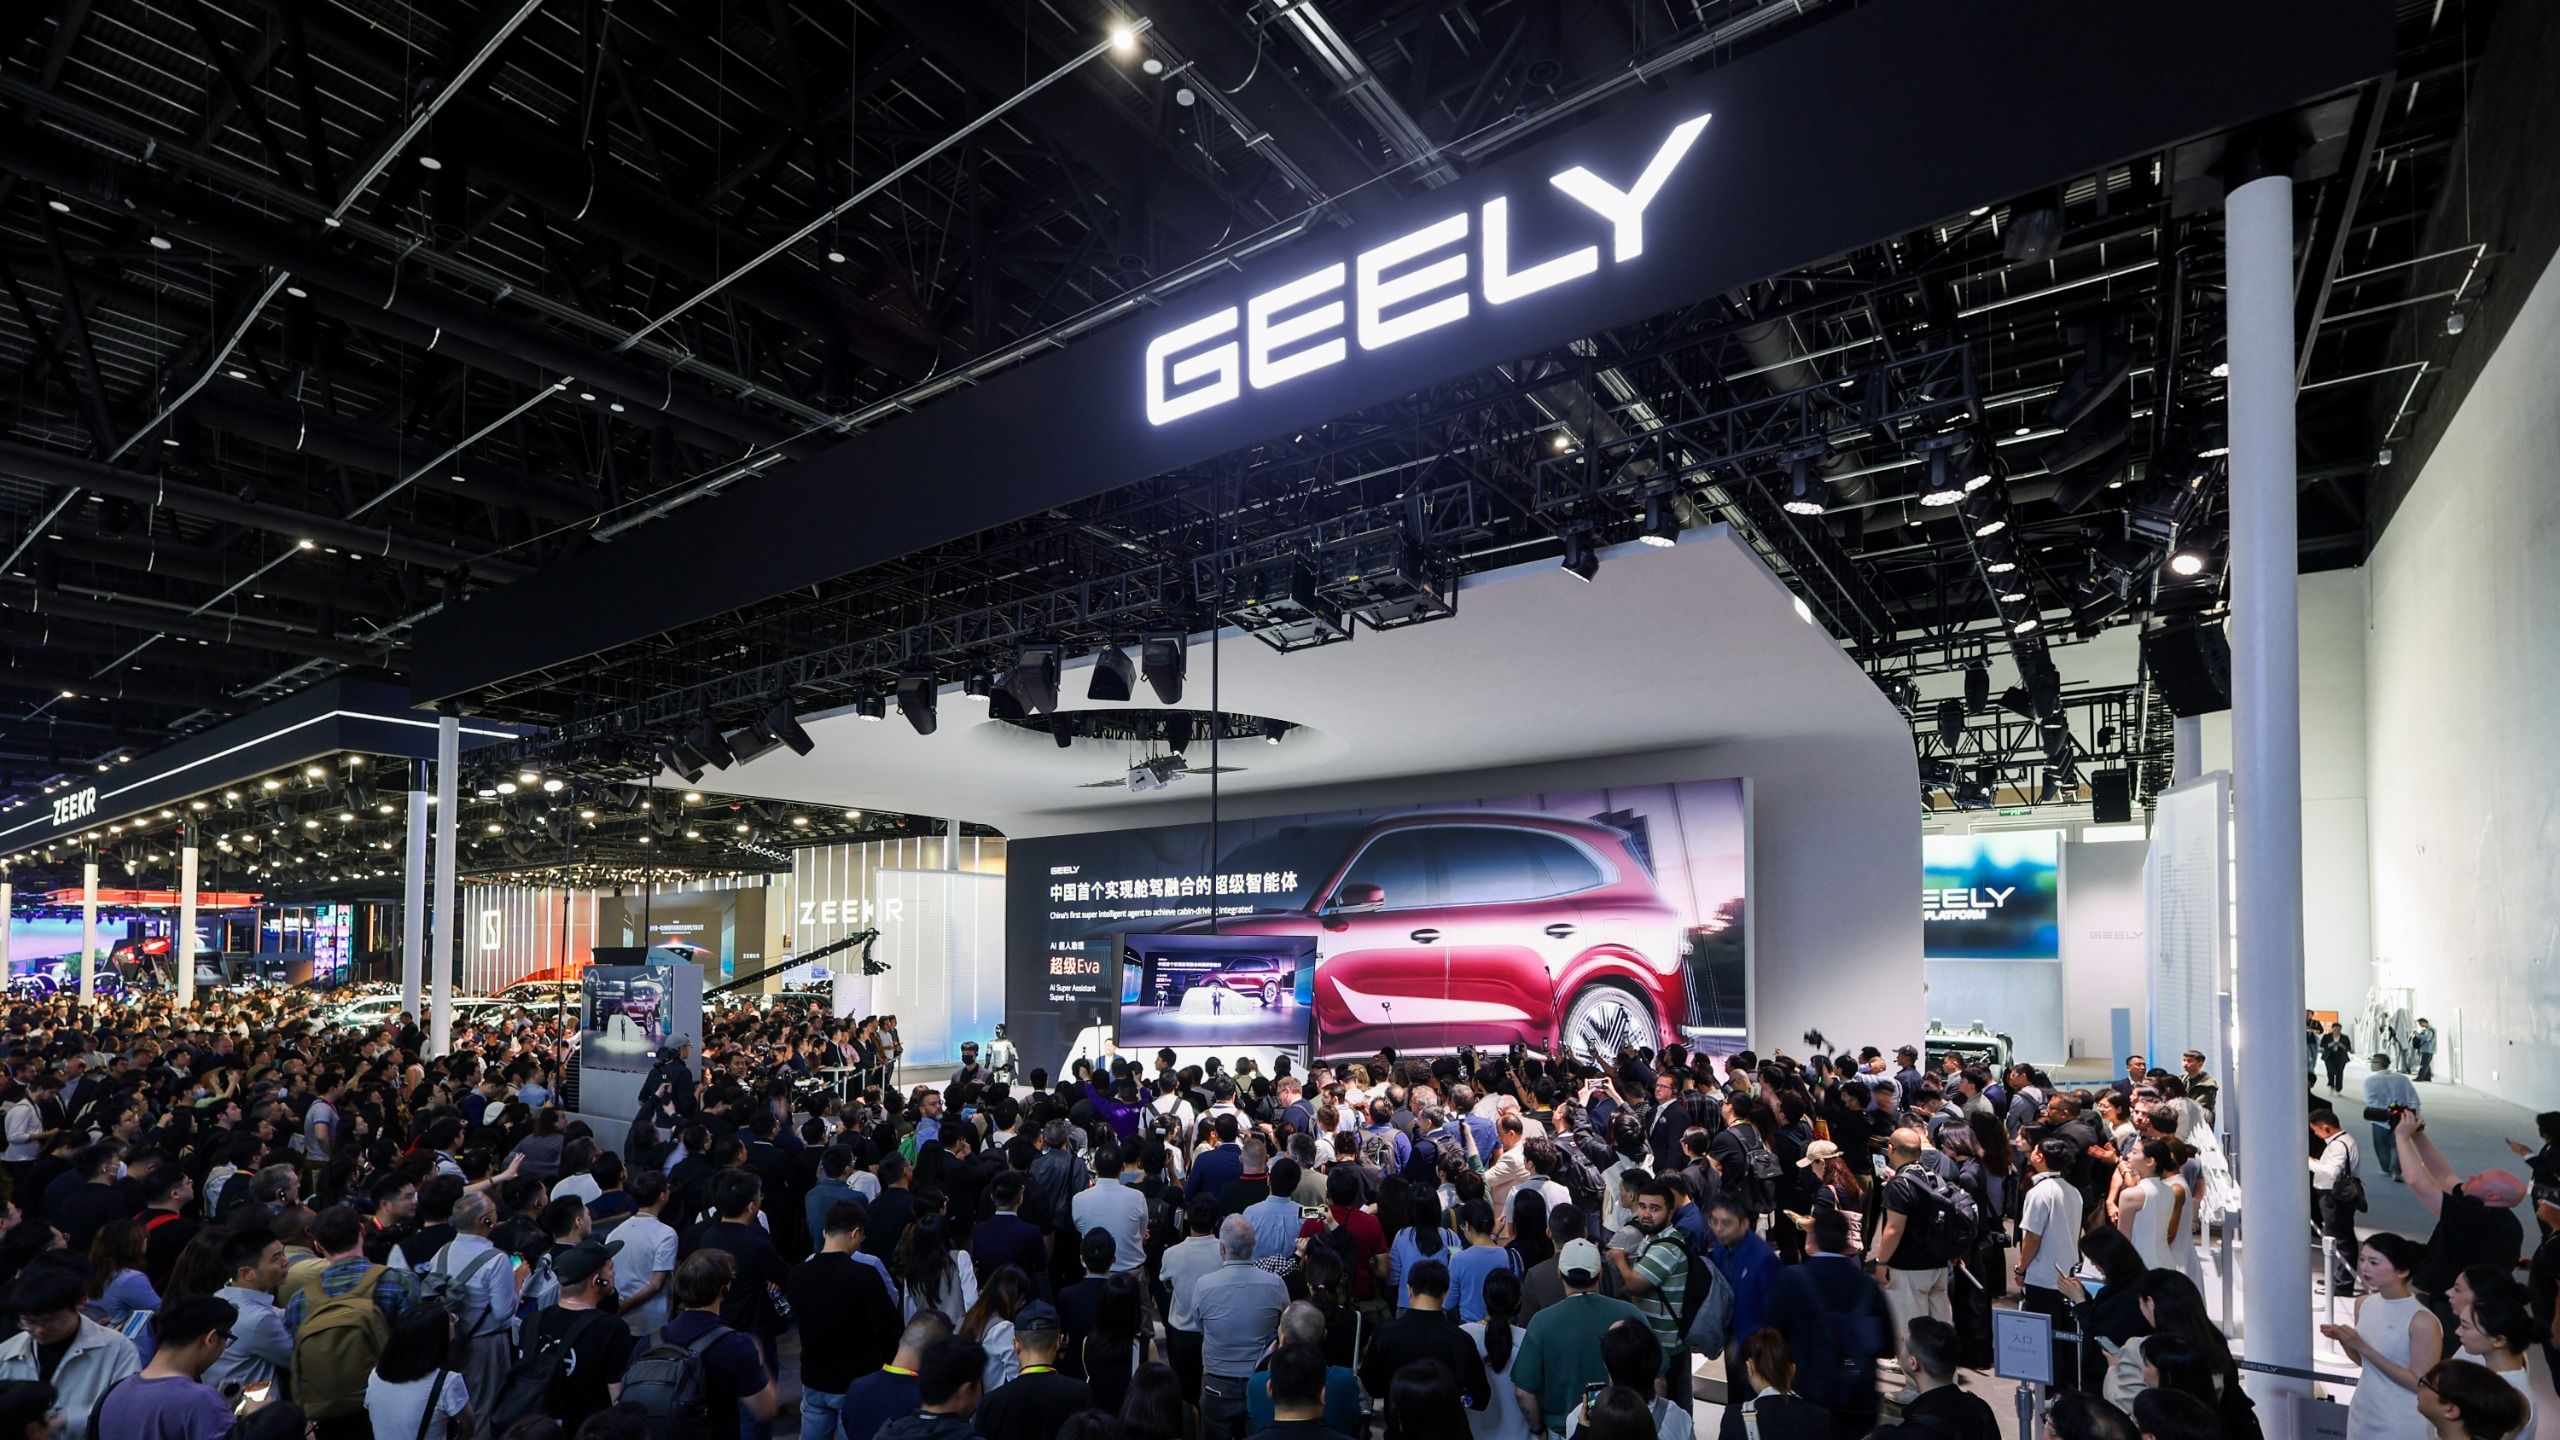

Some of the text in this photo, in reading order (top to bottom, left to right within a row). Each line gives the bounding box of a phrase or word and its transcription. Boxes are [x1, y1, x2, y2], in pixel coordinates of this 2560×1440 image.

[1146, 113, 1712, 426] GEELY
[53, 786, 96, 826] ZEEKR
[1050, 866, 1080, 875] GEELY
[1050, 871, 1298, 902] 中国首个实现舱驾融合的超级智能体
[1923, 886, 2016, 909] EELY
[1049, 911, 1069, 920] China's
[1070, 910, 1081, 919] first
[1082, 911, 1098, 920] super
[1098, 909, 1126, 919] intelligent
[1127, 909, 1145, 919] agent
[1145, 909, 1152, 917] to
[1152, 907, 1176, 916] achieve
[1219, 904, 1254, 916] integrated
[2090, 931, 2144, 940] GEELY
[1050, 956, 1100, 975] 超级Eva
[1056, 984, 1072, 993] Super
[1072, 984, 1096, 992] Assistant
[1049, 994, 1065, 1002] Super
[2012, 1333, 2033, 1345] 入口
